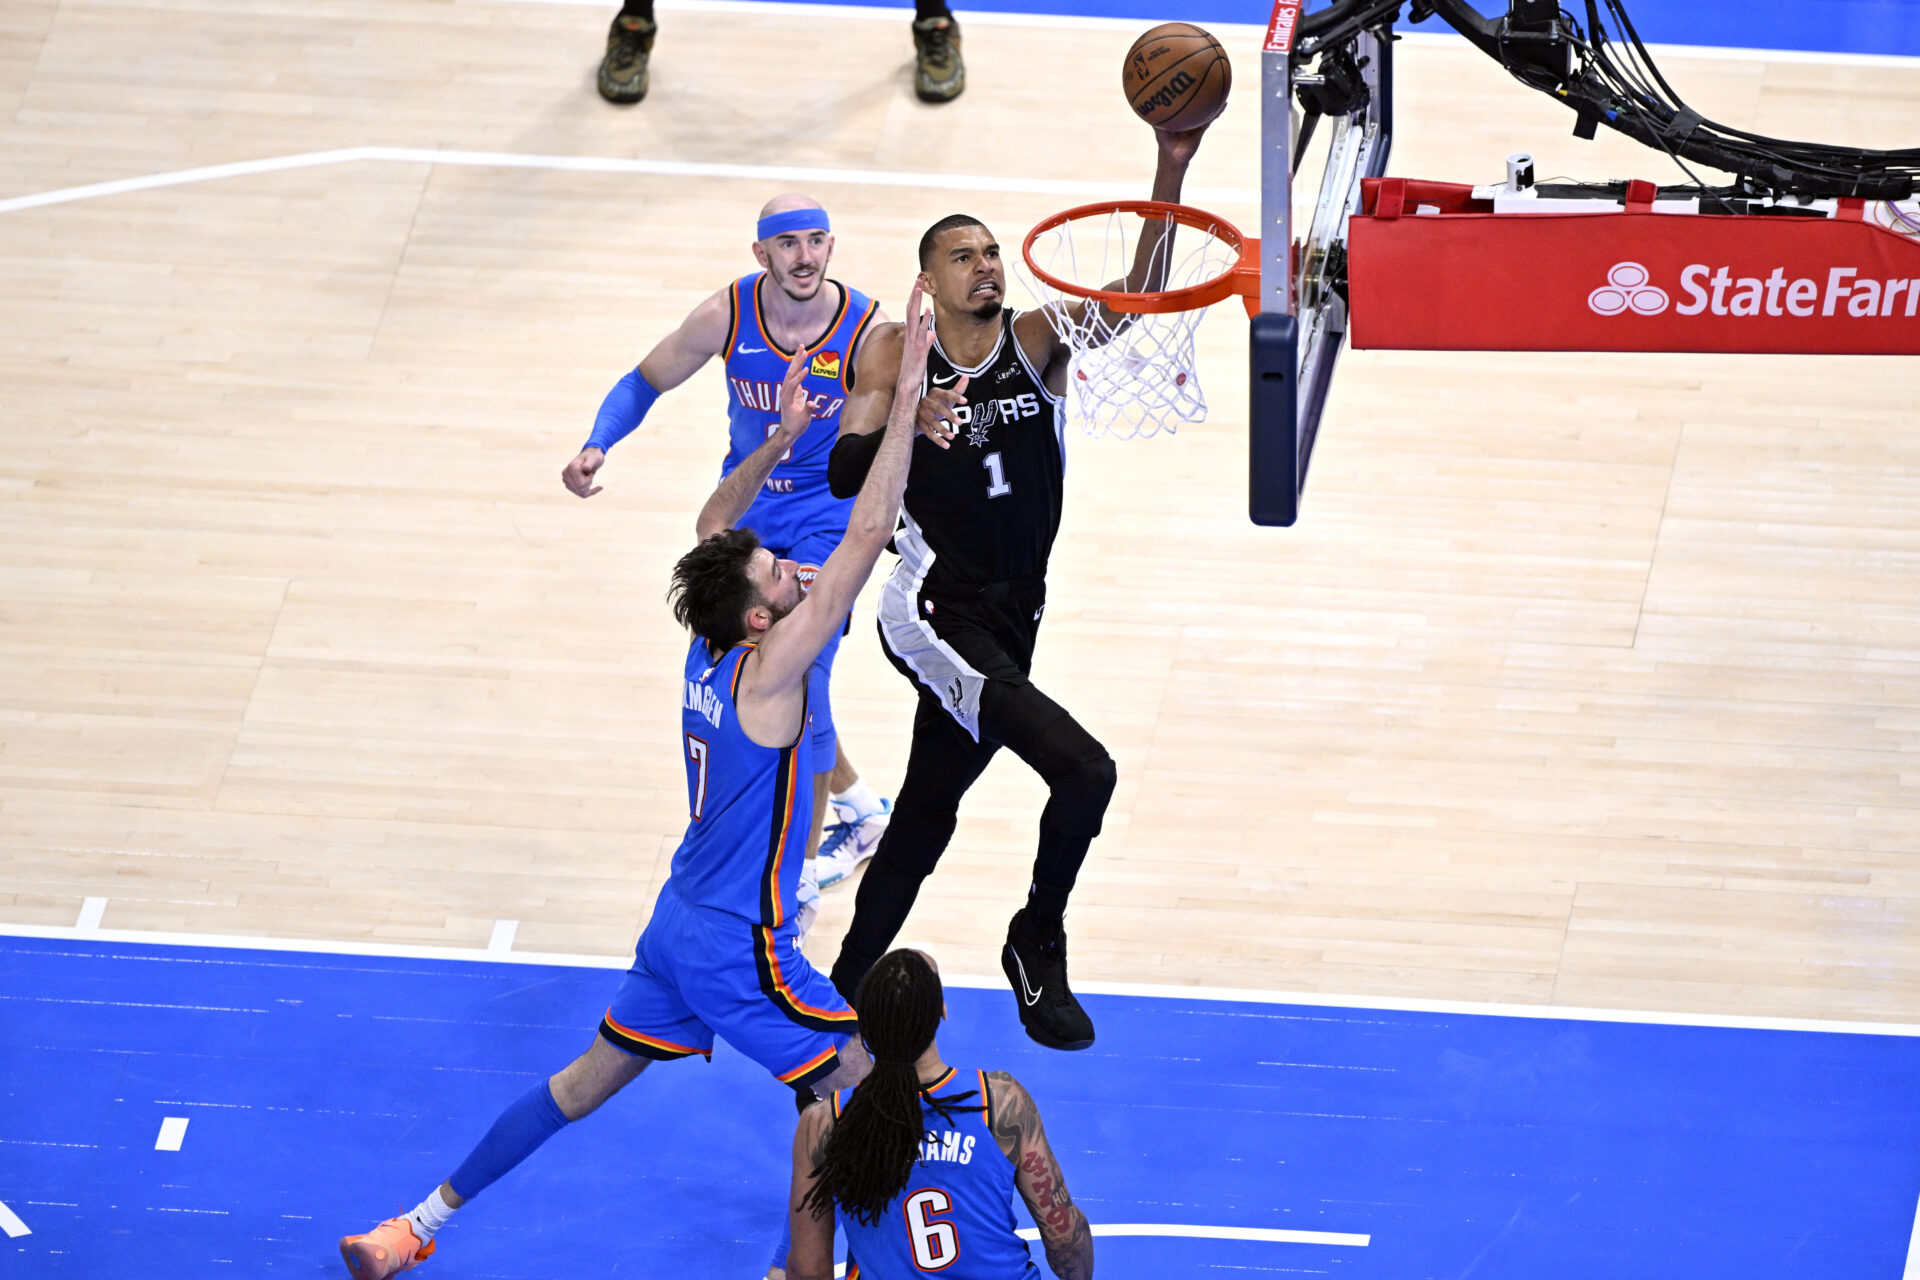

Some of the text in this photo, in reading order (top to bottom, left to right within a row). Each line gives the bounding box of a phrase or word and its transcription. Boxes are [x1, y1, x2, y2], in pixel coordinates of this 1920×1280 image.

[1266, 7, 1297, 50] Emirates
[1136, 71, 1196, 116] Wilson
[1676, 264, 1818, 317] State
[983, 452, 1012, 499] 1
[686, 732, 709, 822] 7
[903, 1187, 960, 1272] 6
